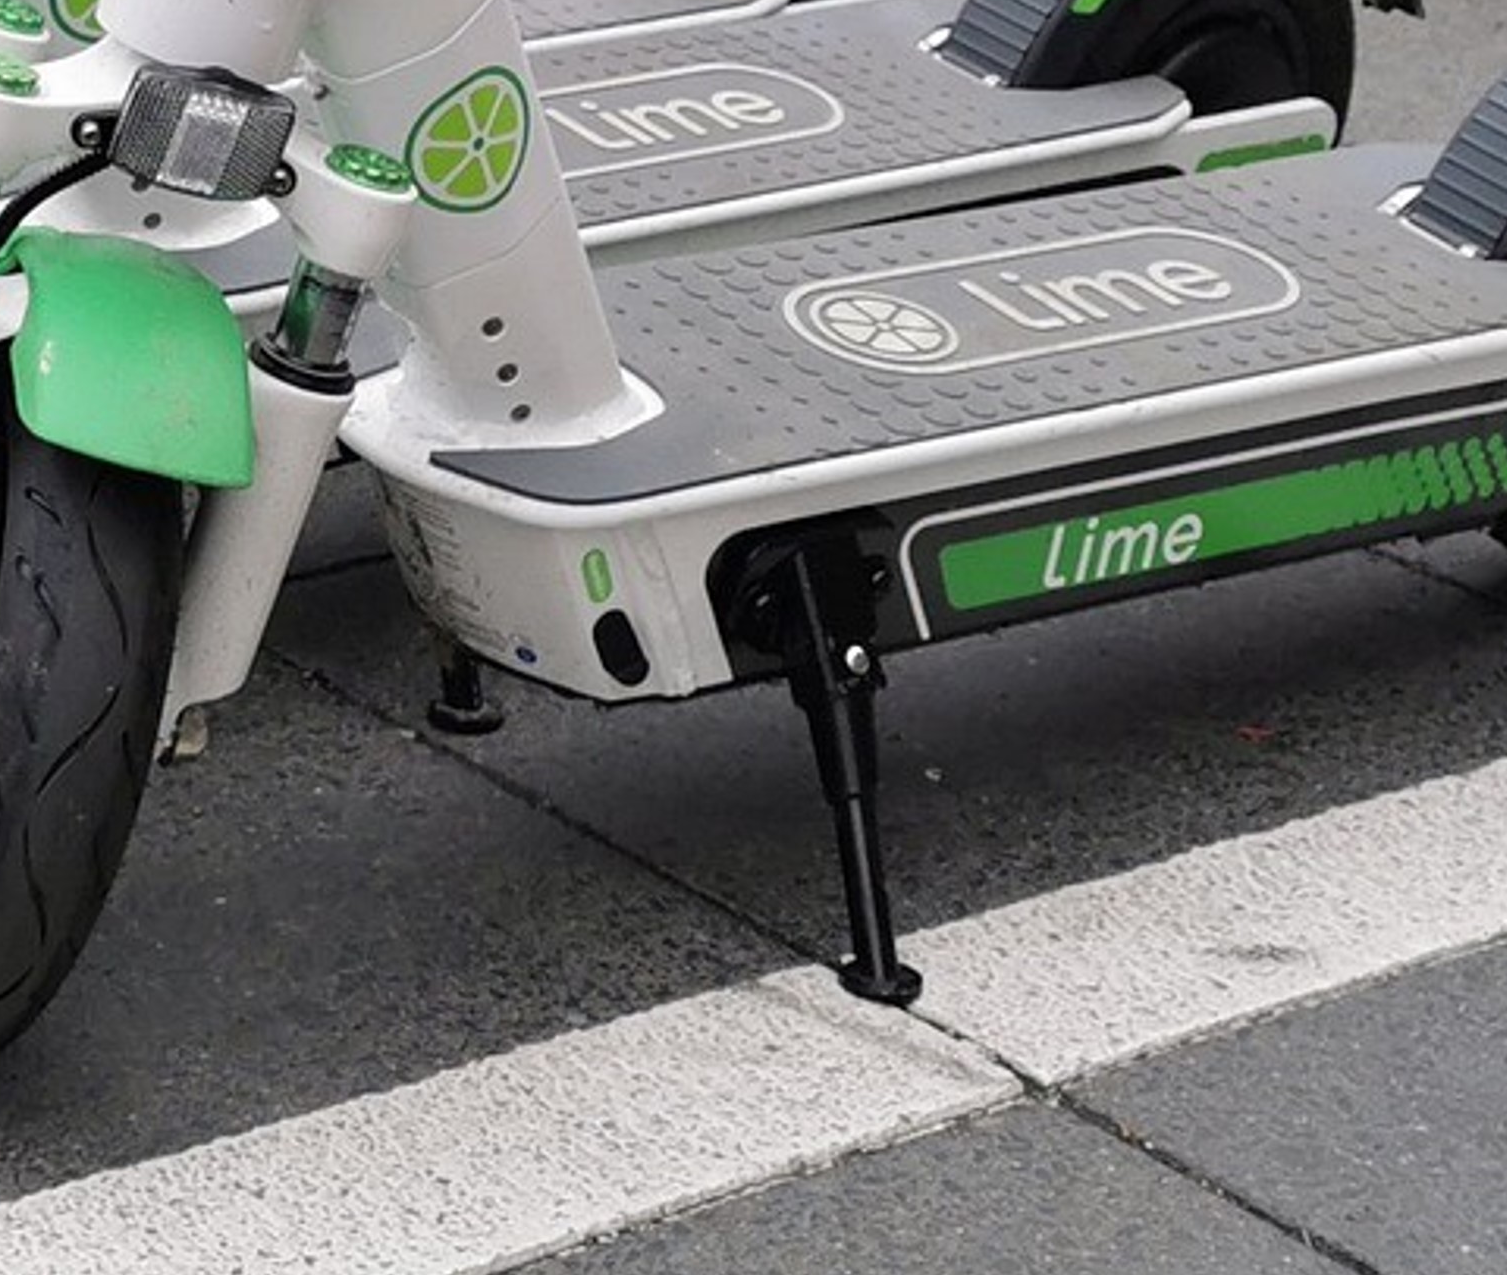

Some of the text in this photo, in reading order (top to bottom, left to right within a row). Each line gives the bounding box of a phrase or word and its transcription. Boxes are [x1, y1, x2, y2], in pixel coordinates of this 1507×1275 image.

[544, 89, 786, 150] Lime
[957, 258, 1234, 332] Lime
[1043, 512, 1204, 589] Lime
